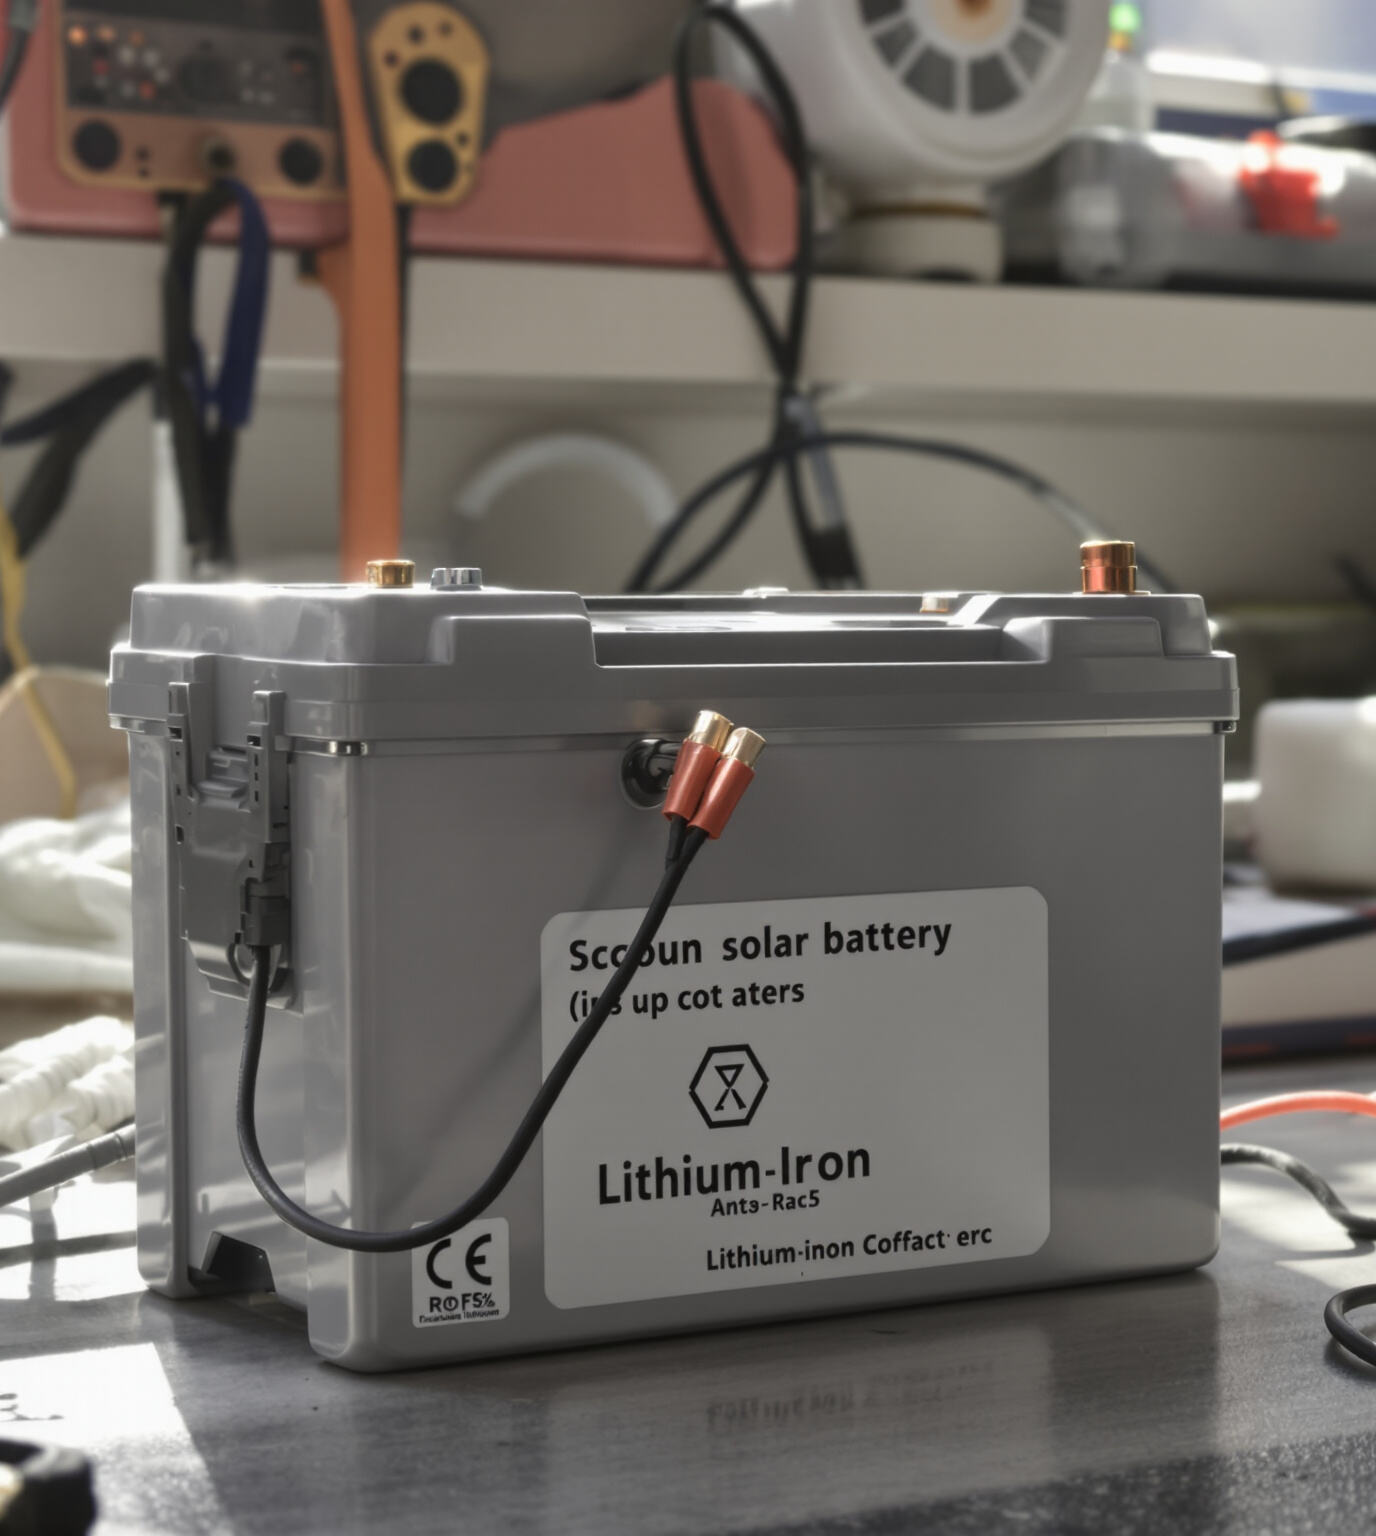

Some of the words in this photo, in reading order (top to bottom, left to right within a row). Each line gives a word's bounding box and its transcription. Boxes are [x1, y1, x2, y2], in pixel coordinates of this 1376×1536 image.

[722, 925, 809, 962] solar
[824, 921, 952, 956] battery
[632, 992, 669, 1020] up
[677, 985, 723, 1011] cot
[732, 982, 805, 1007] aters
[956, 1227, 993, 1247] erc
[426, 1233, 492, 1290] CE
